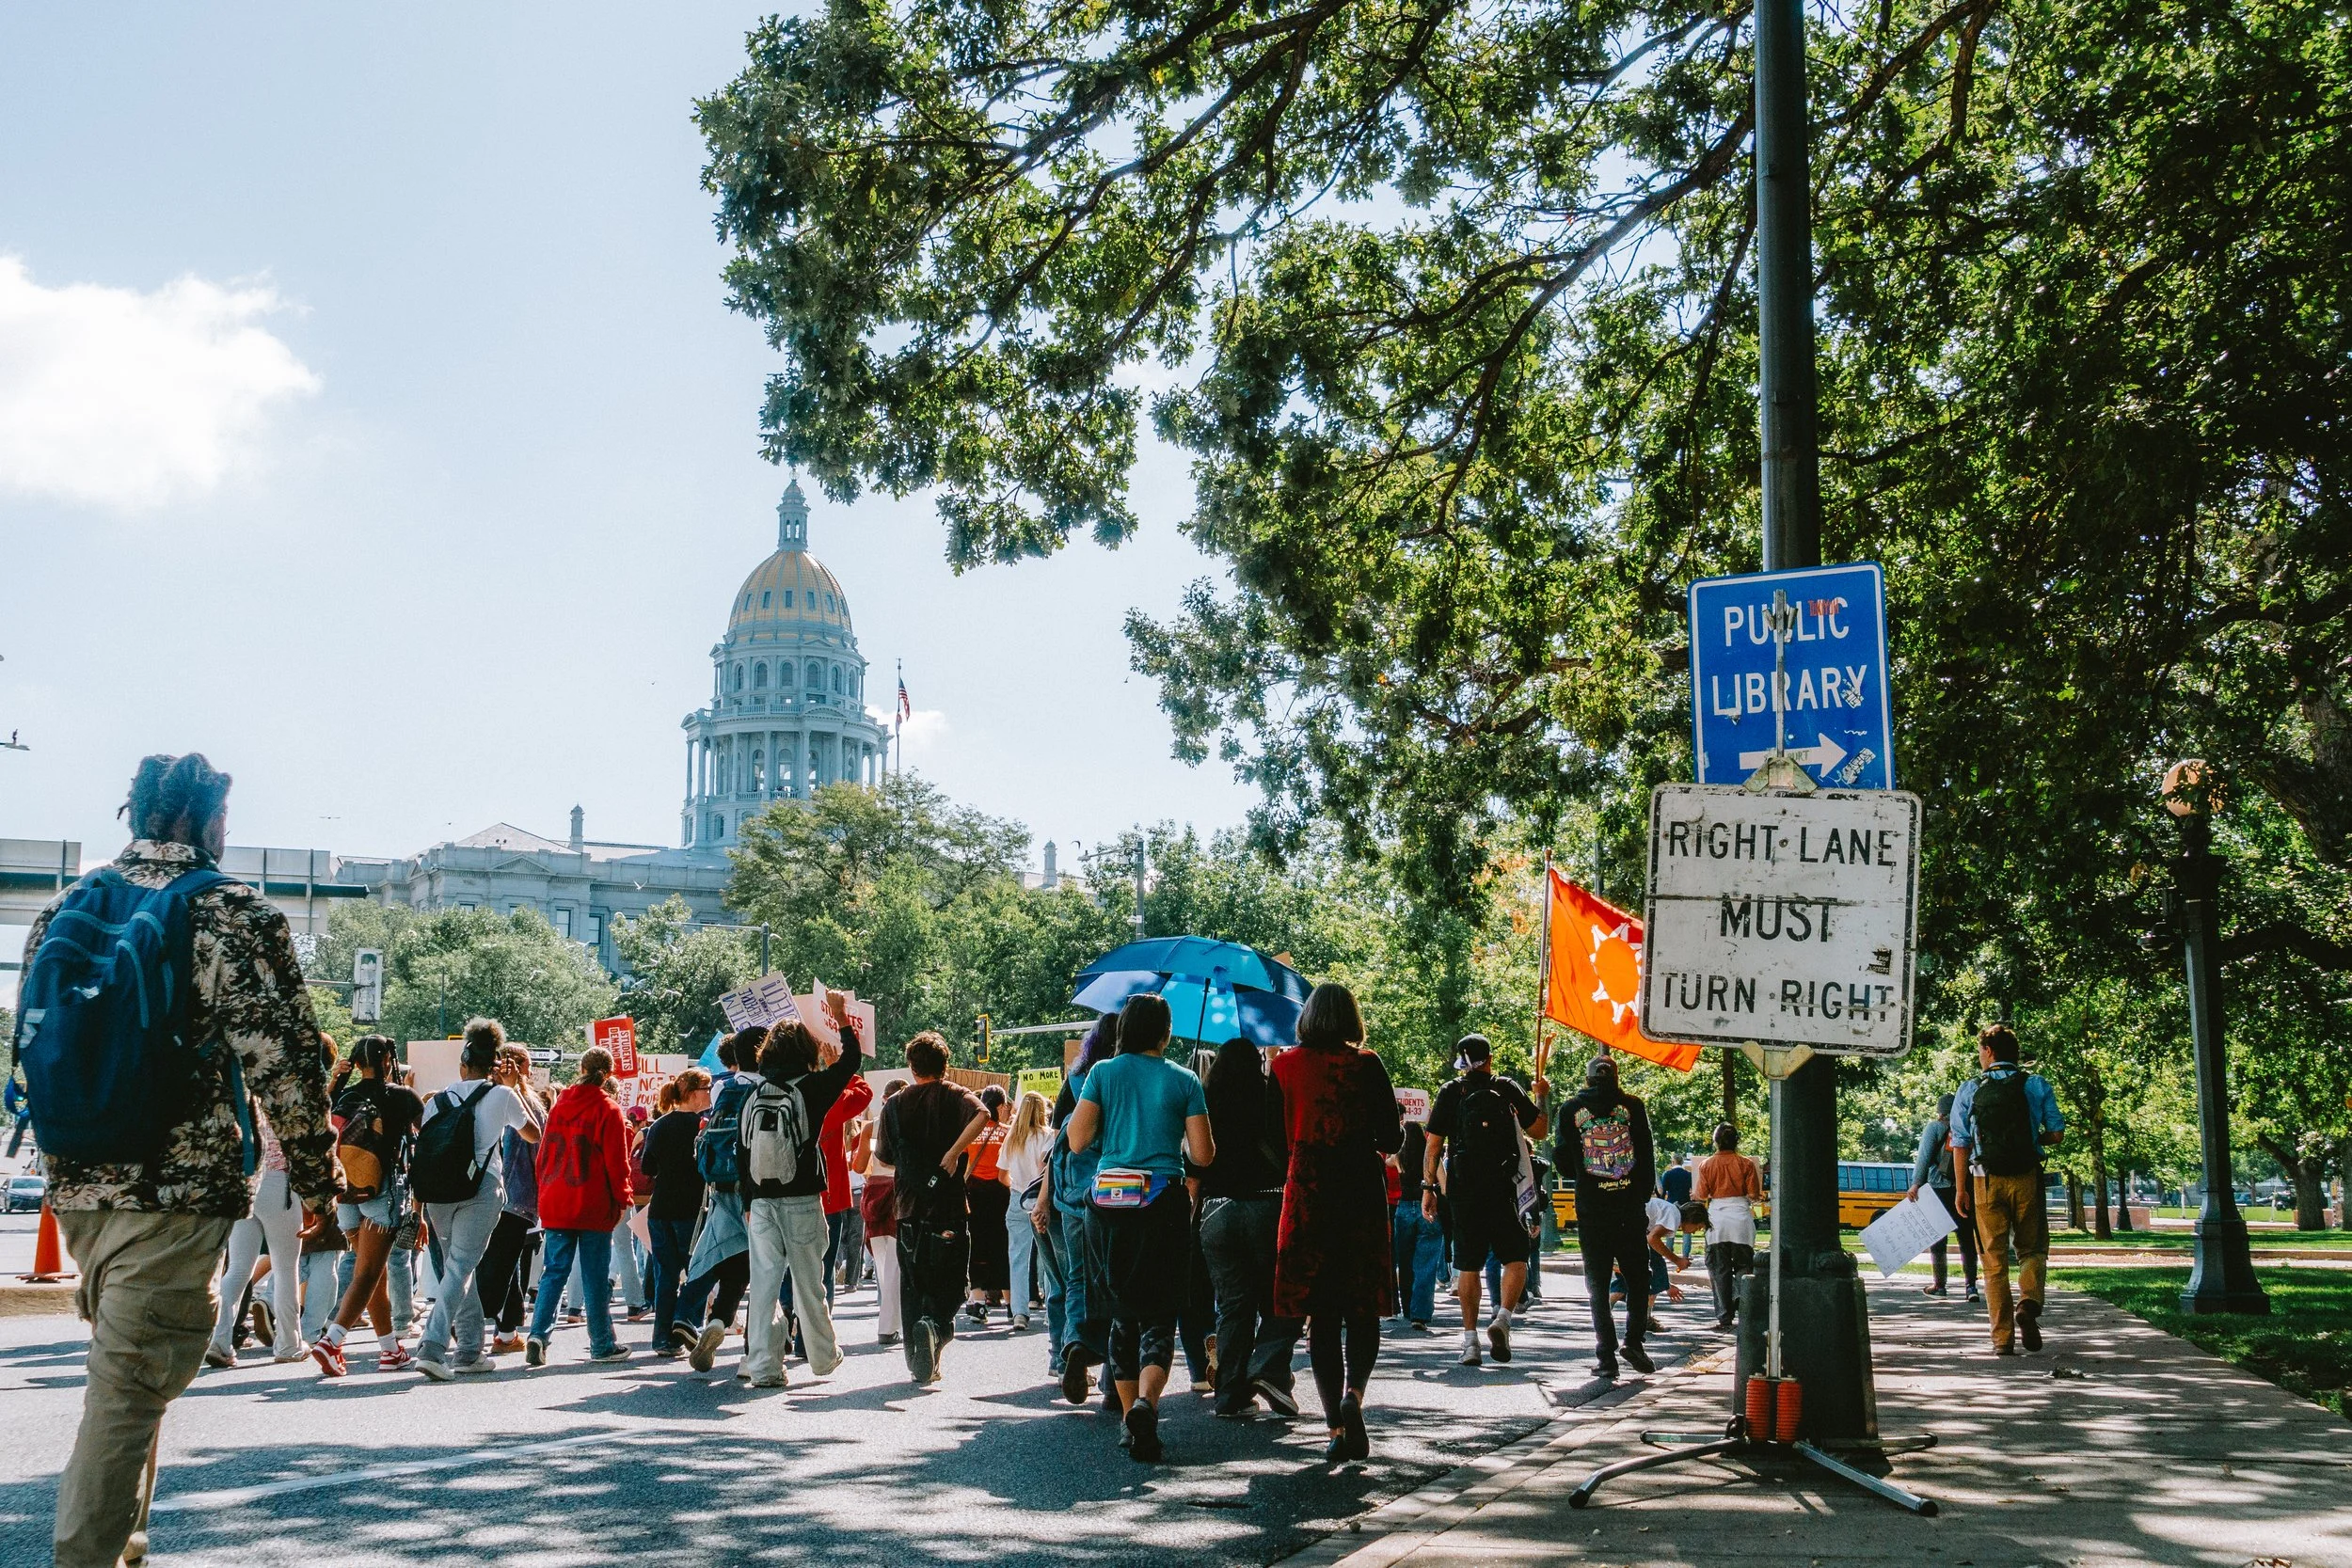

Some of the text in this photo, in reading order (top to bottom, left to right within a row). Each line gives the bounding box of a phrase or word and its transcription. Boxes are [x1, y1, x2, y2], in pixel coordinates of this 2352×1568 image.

[1712, 665, 1867, 716] LIBRARY
[1669, 821, 1897, 866] RIGHT LANE
[1720, 892, 1838, 942] MUST
[1661, 973, 1894, 1022] TURN RIGHT
[610, 1028, 621, 1058] DEMAND
[621, 1031, 632, 1069] STUDENTS
[639, 1057, 666, 1074] ILL
[1023, 1070, 1058, 1082] NO MORE
[1396, 1098, 1425, 1107] TUDENTS
